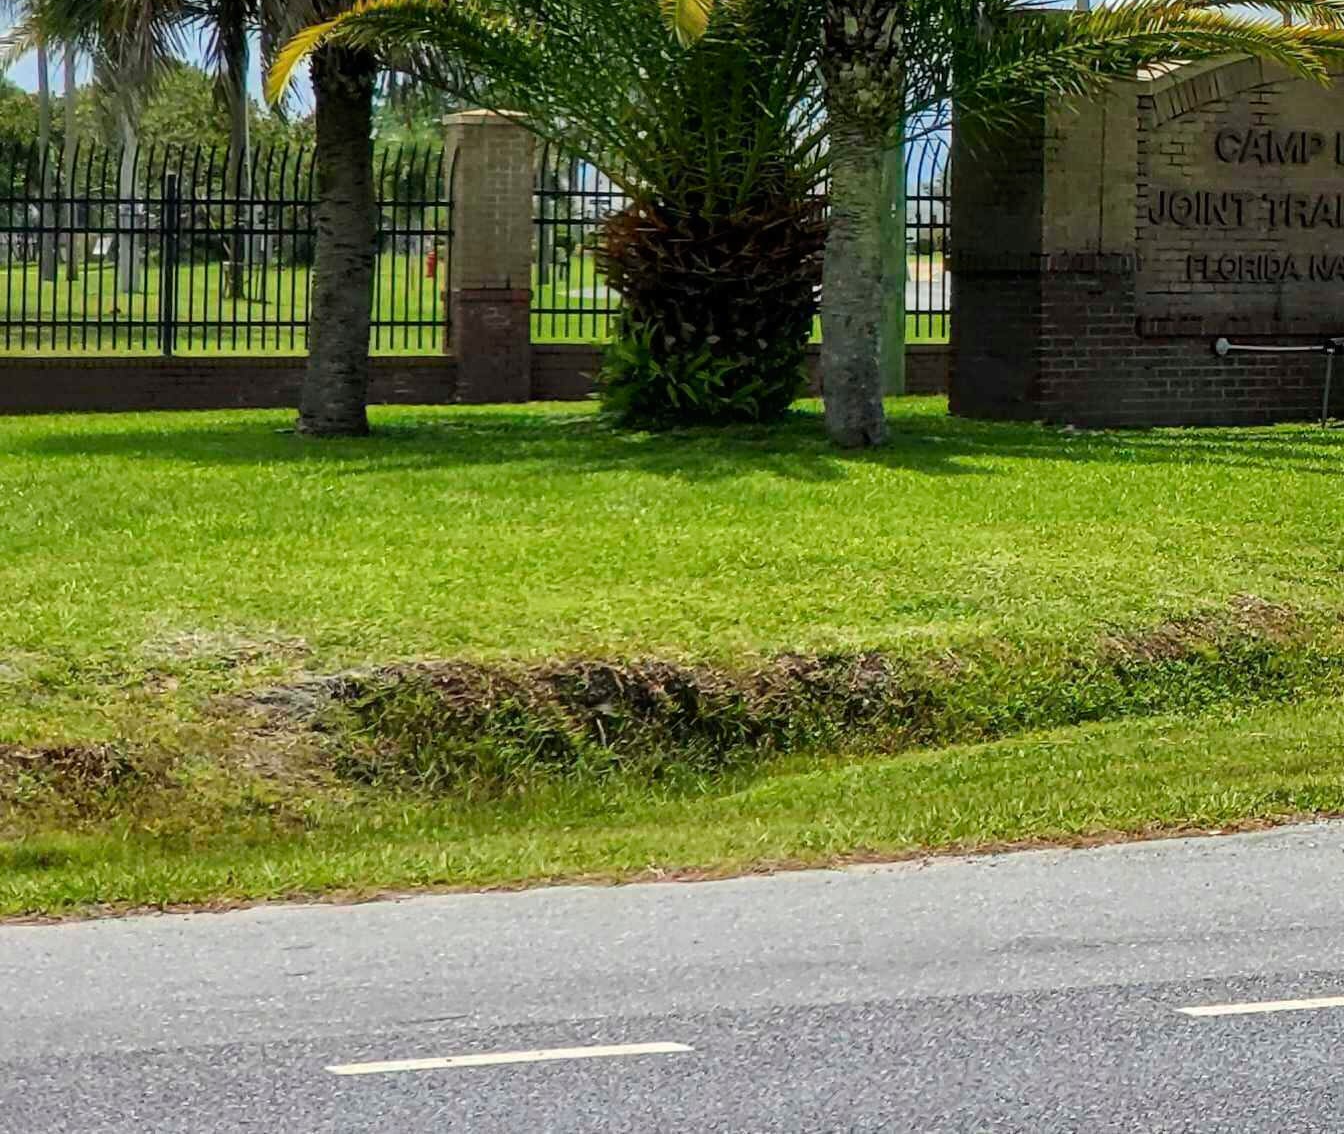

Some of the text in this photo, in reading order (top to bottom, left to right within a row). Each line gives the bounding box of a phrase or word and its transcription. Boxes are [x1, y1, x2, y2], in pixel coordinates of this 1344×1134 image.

[1215, 129, 1326, 165] CAMP
[1148, 191, 1254, 227] JOINT
[1185, 254, 1299, 282] FLORIDA
